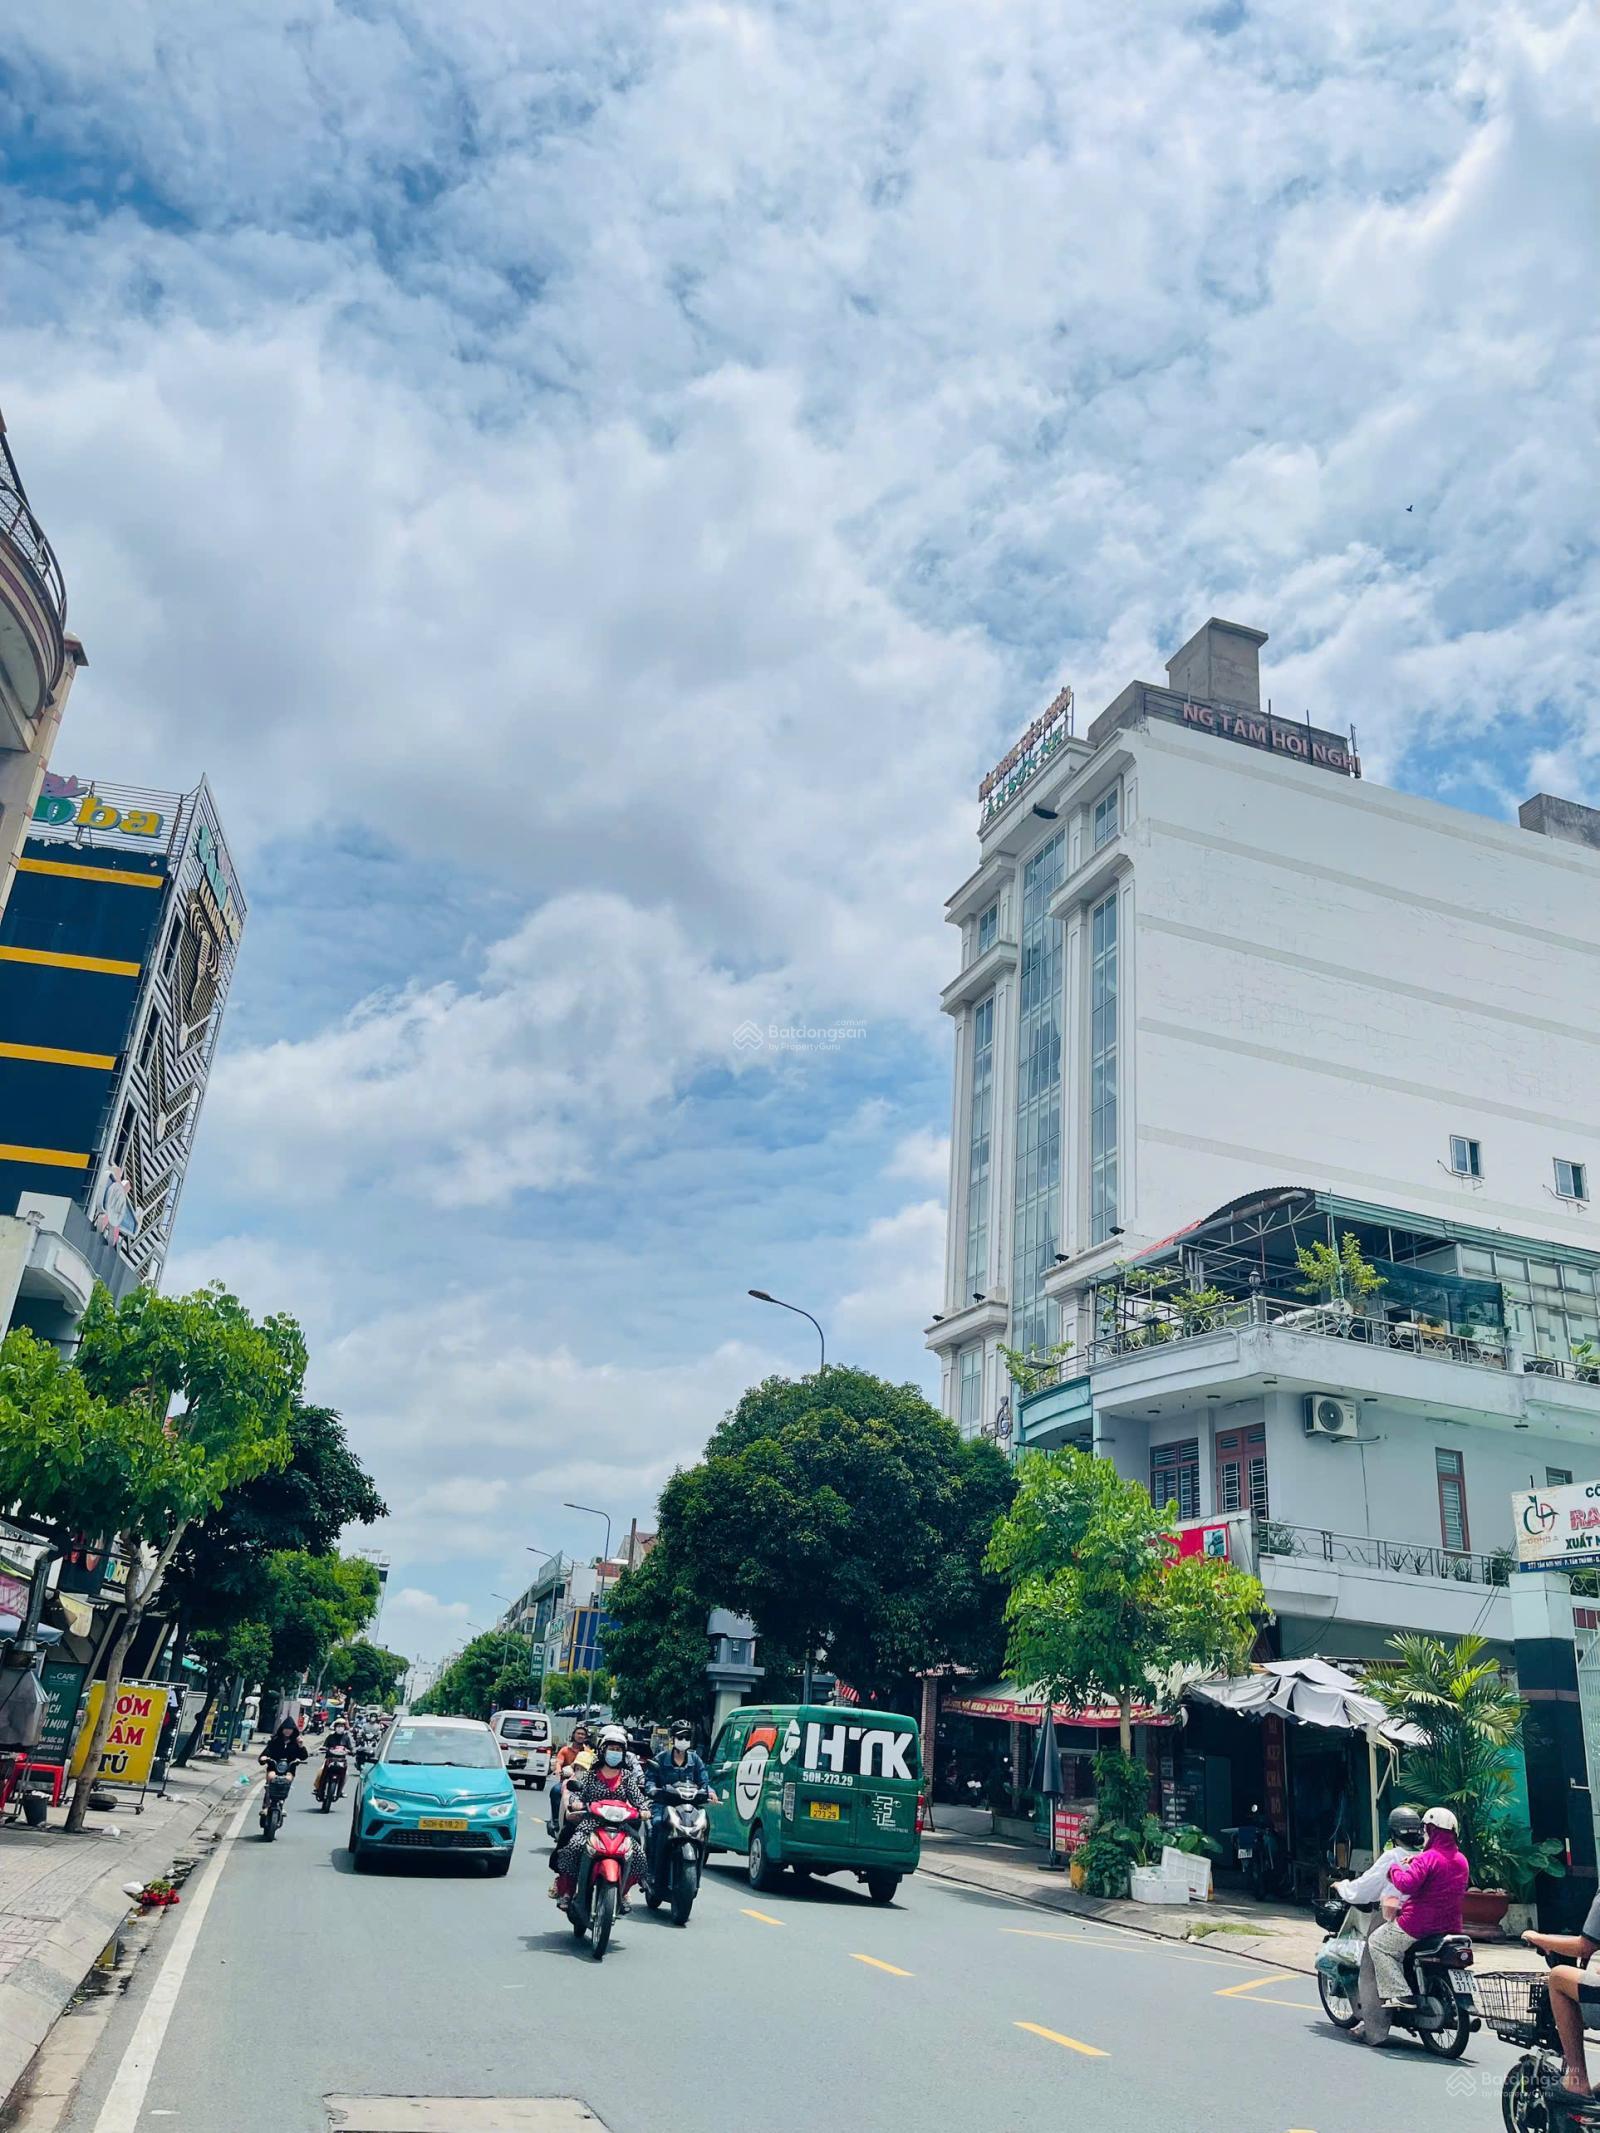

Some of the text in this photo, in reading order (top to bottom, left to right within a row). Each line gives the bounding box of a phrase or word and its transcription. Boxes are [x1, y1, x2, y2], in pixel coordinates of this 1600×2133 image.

[1183, 702, 1213, 727] NG
[1219, 712, 1266, 744] TÂM
[116, 1694, 153, 1717] ƠM
[106, 1717, 146, 1746] ẤM
[803, 1771, 853, 1787] 50H-273.29
